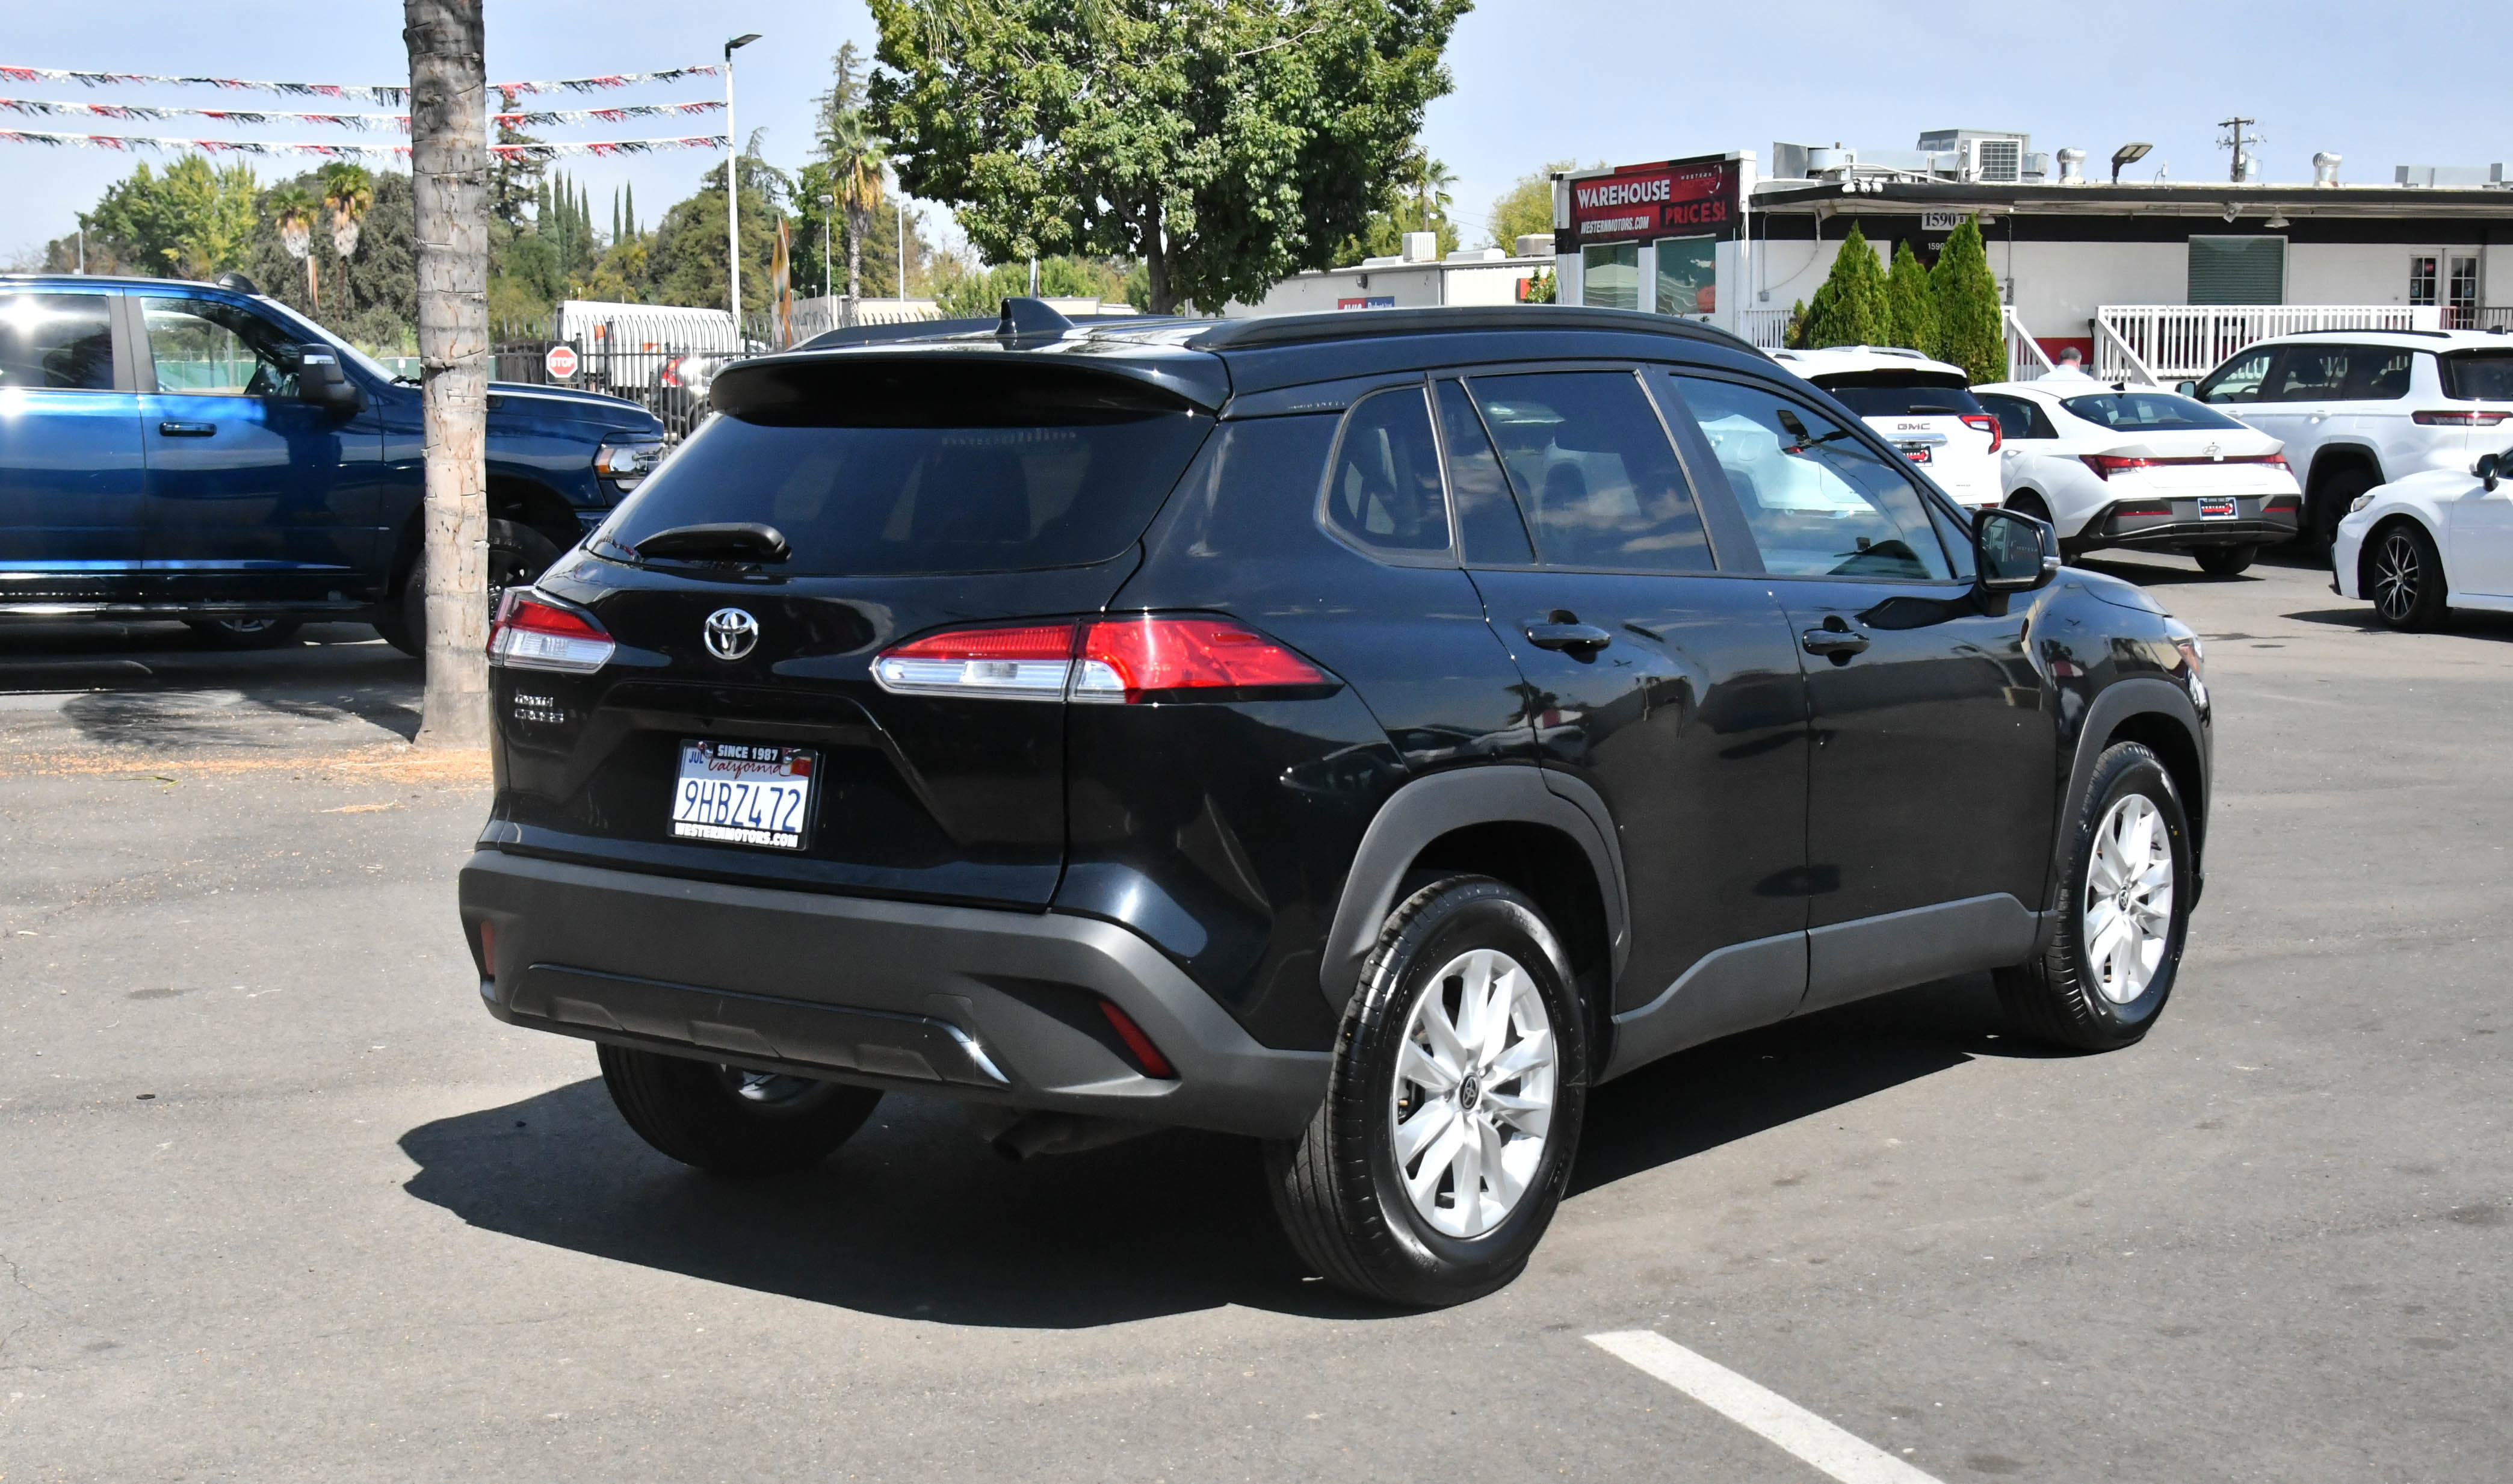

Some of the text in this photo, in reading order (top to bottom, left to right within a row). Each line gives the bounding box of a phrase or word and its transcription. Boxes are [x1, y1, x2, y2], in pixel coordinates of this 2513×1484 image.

[1577, 179, 1670, 209] WAREHOUSE
[1666, 200, 1726, 225] PRICES!
[1925, 212, 1956, 227] 1590
[1581, 215, 1649, 234] WESTERNMOTORS.COM
[550, 356, 573, 368] STOP
[688, 750, 704, 764] JUL
[717, 744, 779, 761] SINCE 1987
[681, 781, 801, 832] 9HBZ472
[675, 822, 799, 848] WESTERNMOTORS.COM
